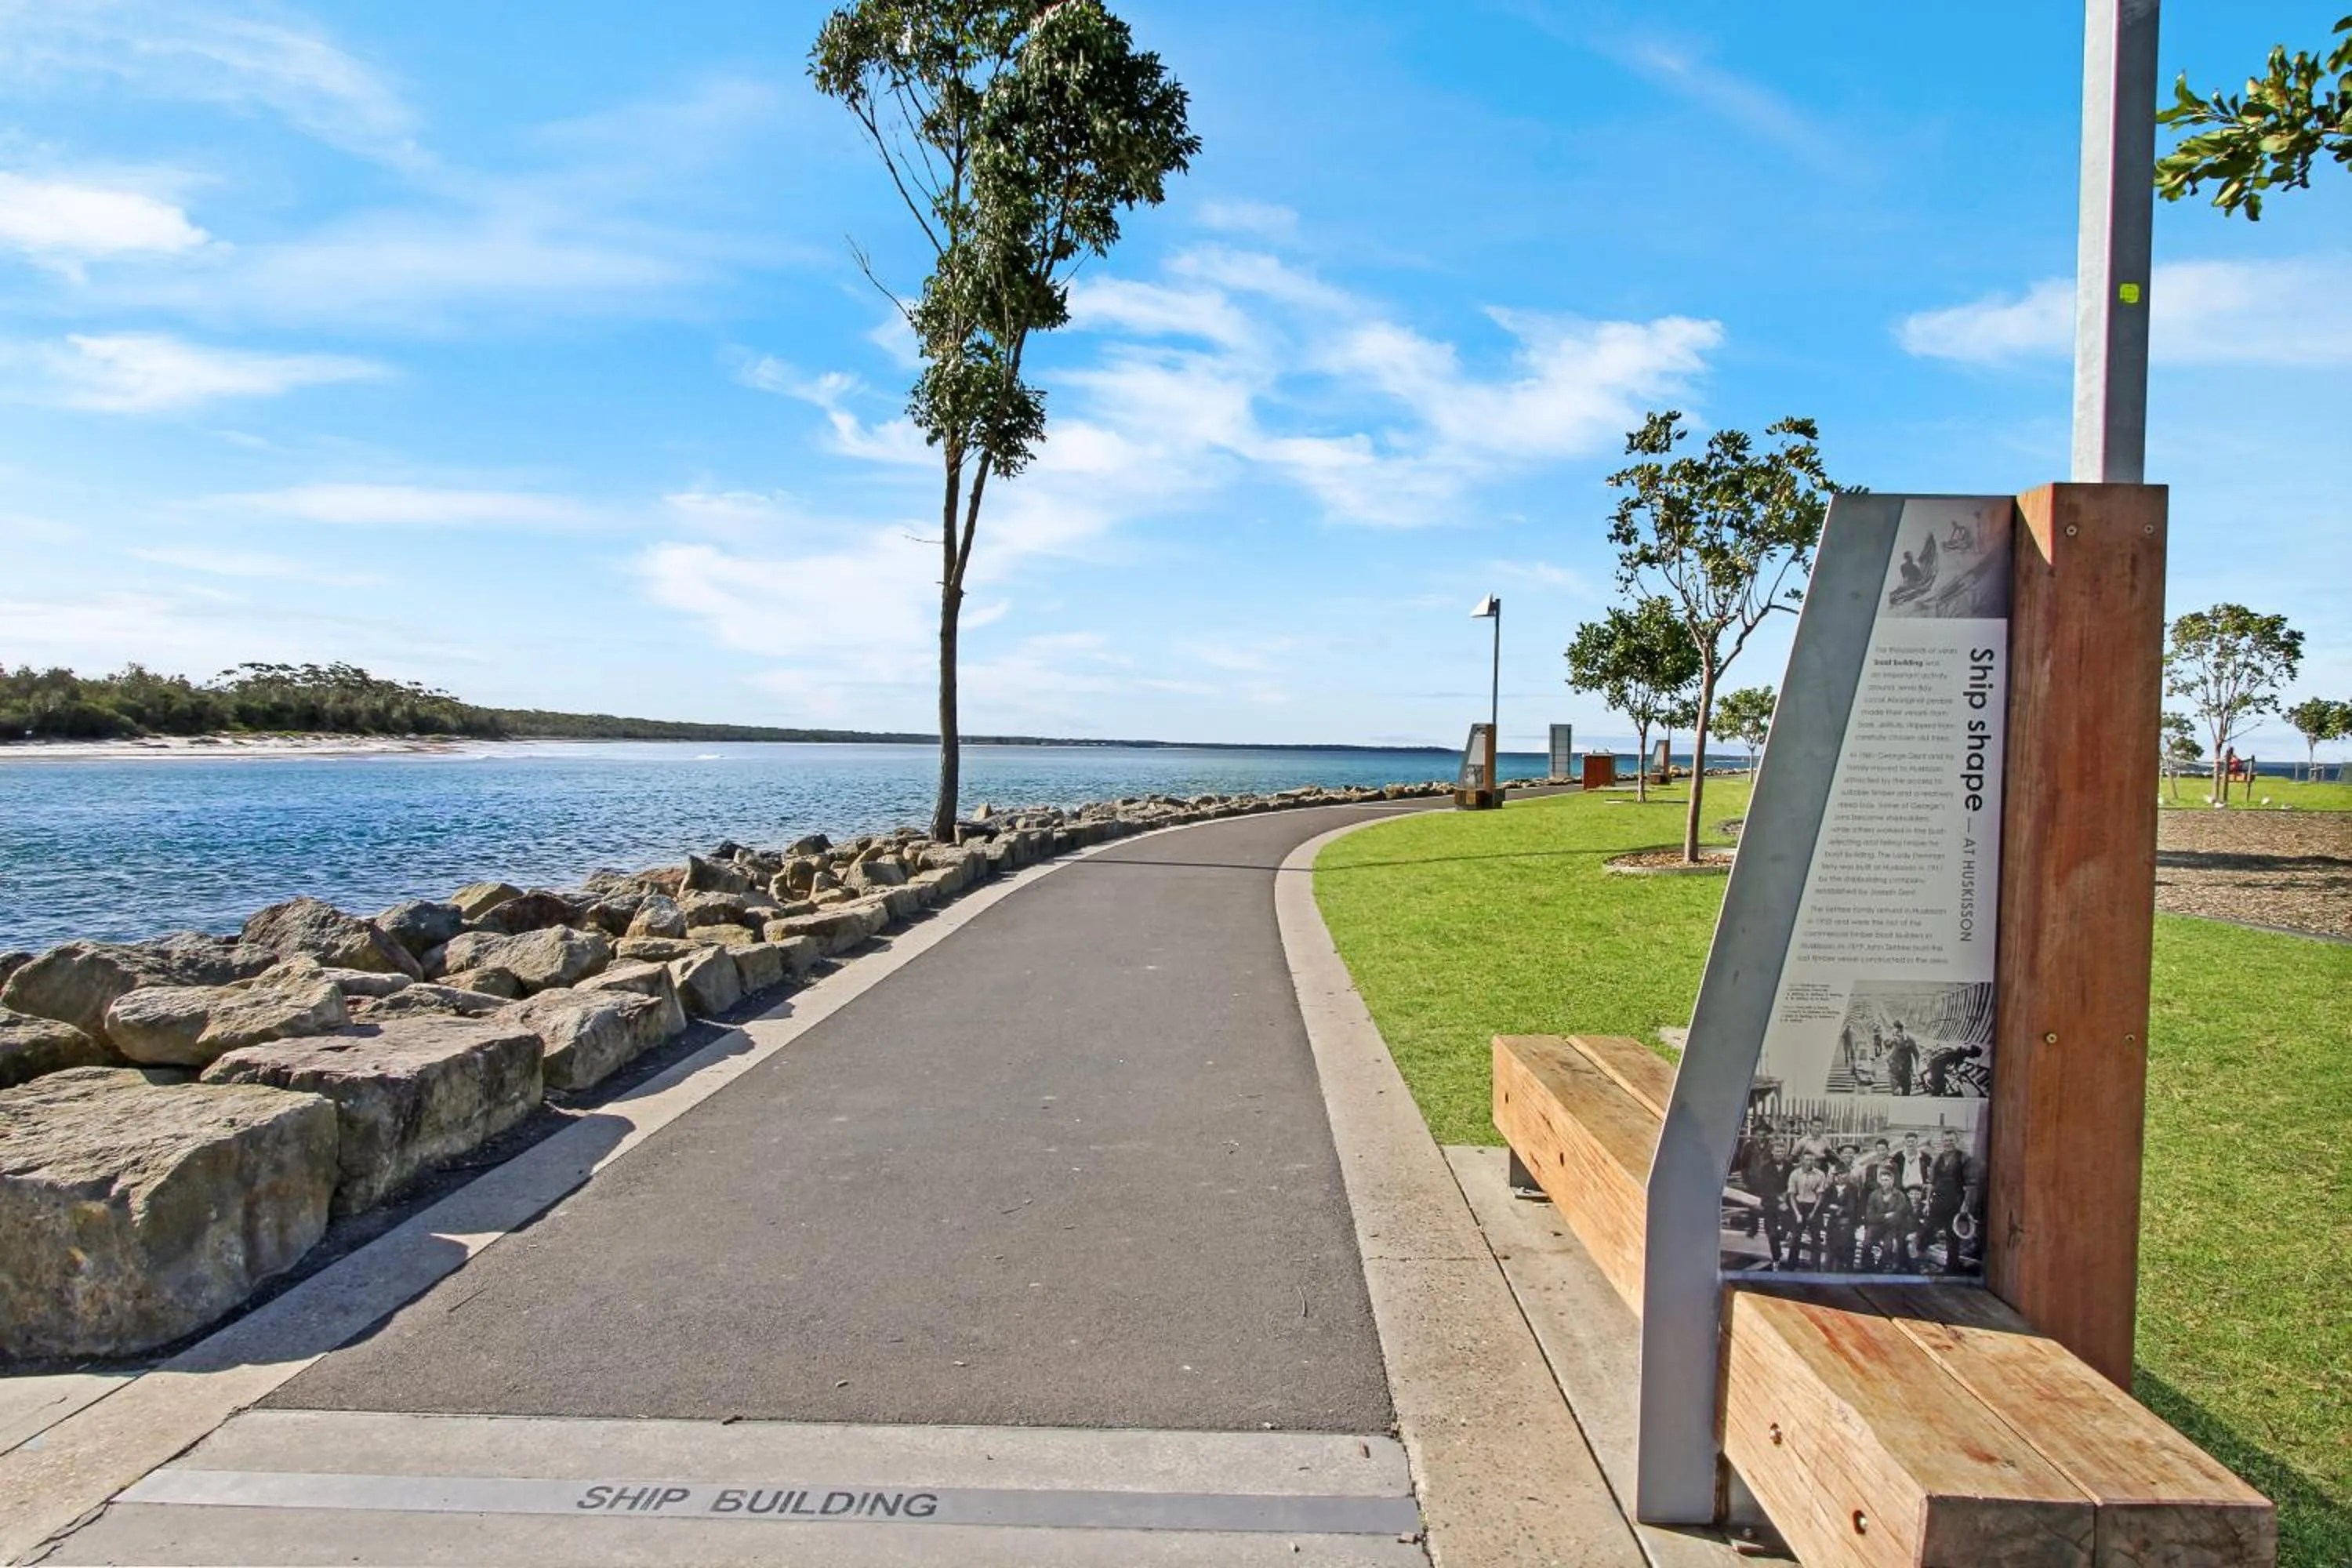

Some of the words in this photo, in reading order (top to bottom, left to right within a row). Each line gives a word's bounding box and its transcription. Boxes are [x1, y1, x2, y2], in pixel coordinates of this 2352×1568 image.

[1963, 648, 1995, 710] Ship
[1960, 720, 1991, 812] shape
[1963, 837, 1976, 855] AT
[1960, 860, 1976, 942] HUSKISSON
[576, 1485, 691, 1512] SHIP
[710, 1488, 940, 1518] BUILDING
